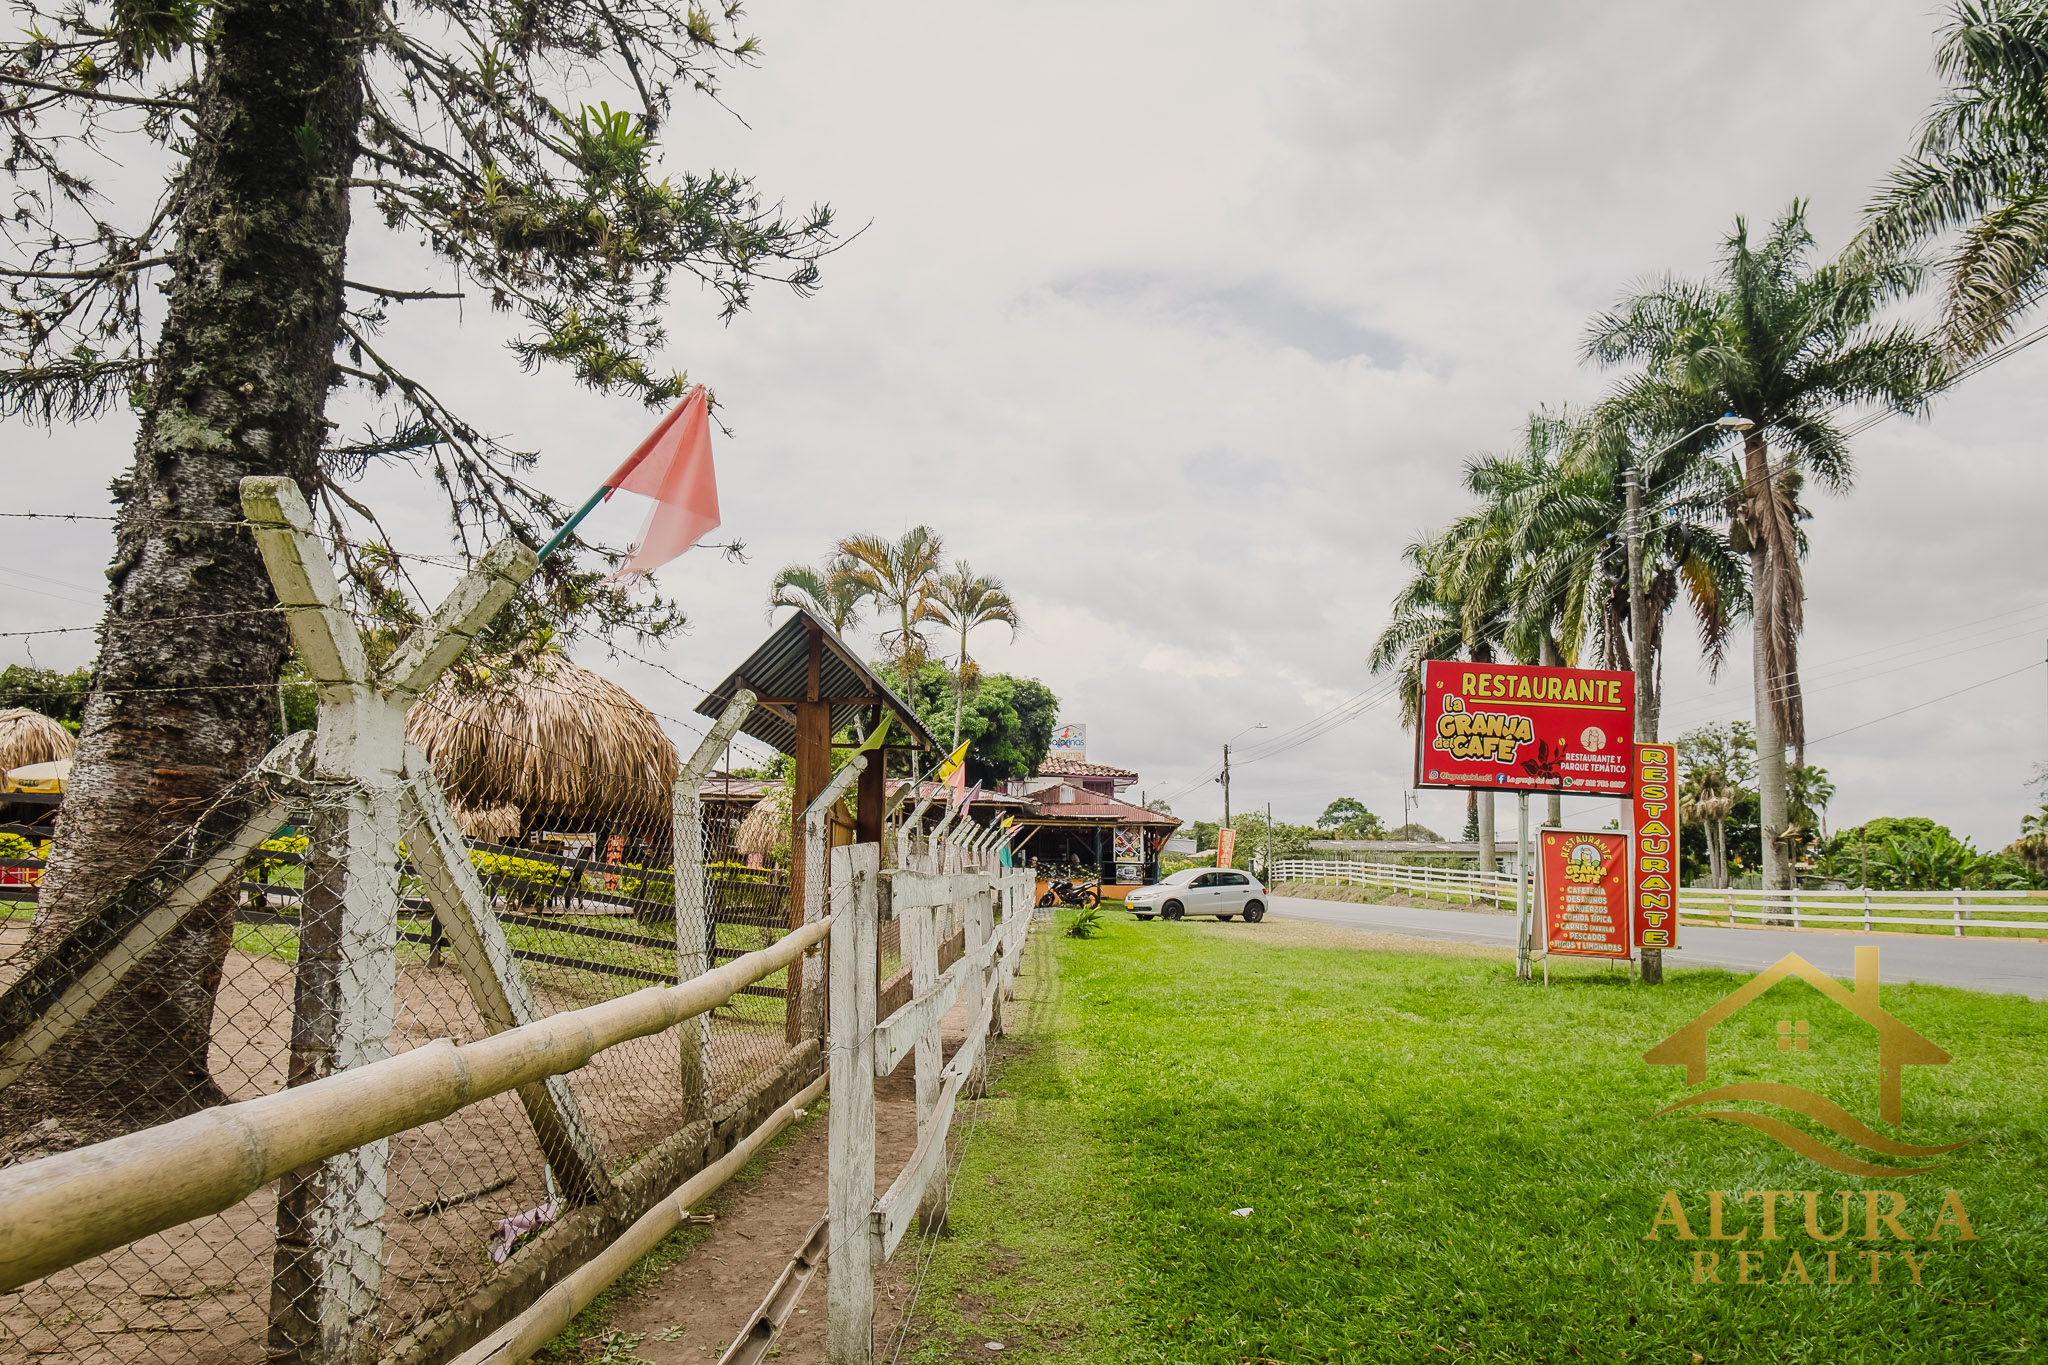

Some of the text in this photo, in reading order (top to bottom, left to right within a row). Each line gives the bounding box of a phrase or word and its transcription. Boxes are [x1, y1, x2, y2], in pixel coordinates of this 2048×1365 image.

[1462, 672, 1622, 704] RESTAURANTE
[1438, 713, 1533, 743] GRANJA
[1434, 733, 1516, 762] del CAFÉ
[1565, 753, 1622, 764] RESTAURANTE Y
[1560, 762, 1627, 773] PARQUE TEMÁTICO
[1560, 835, 1612, 860] RESTAURANTE
[1640, 749, 1671, 945] RESTAURANTE
[1565, 865, 1608, 876] GRANJA
[1566, 895, 1608, 904] DESAYUNOS
[1566, 904, 1608, 914] ALMUERZOS
[1562, 913, 1613, 923] COMIDA TÍPICA
[1560, 922, 1589, 931] CARNES
[1569, 932, 1607, 941] PESCADOS
[1554, 940, 1622, 952] JUGOS Y LIMONADAS
